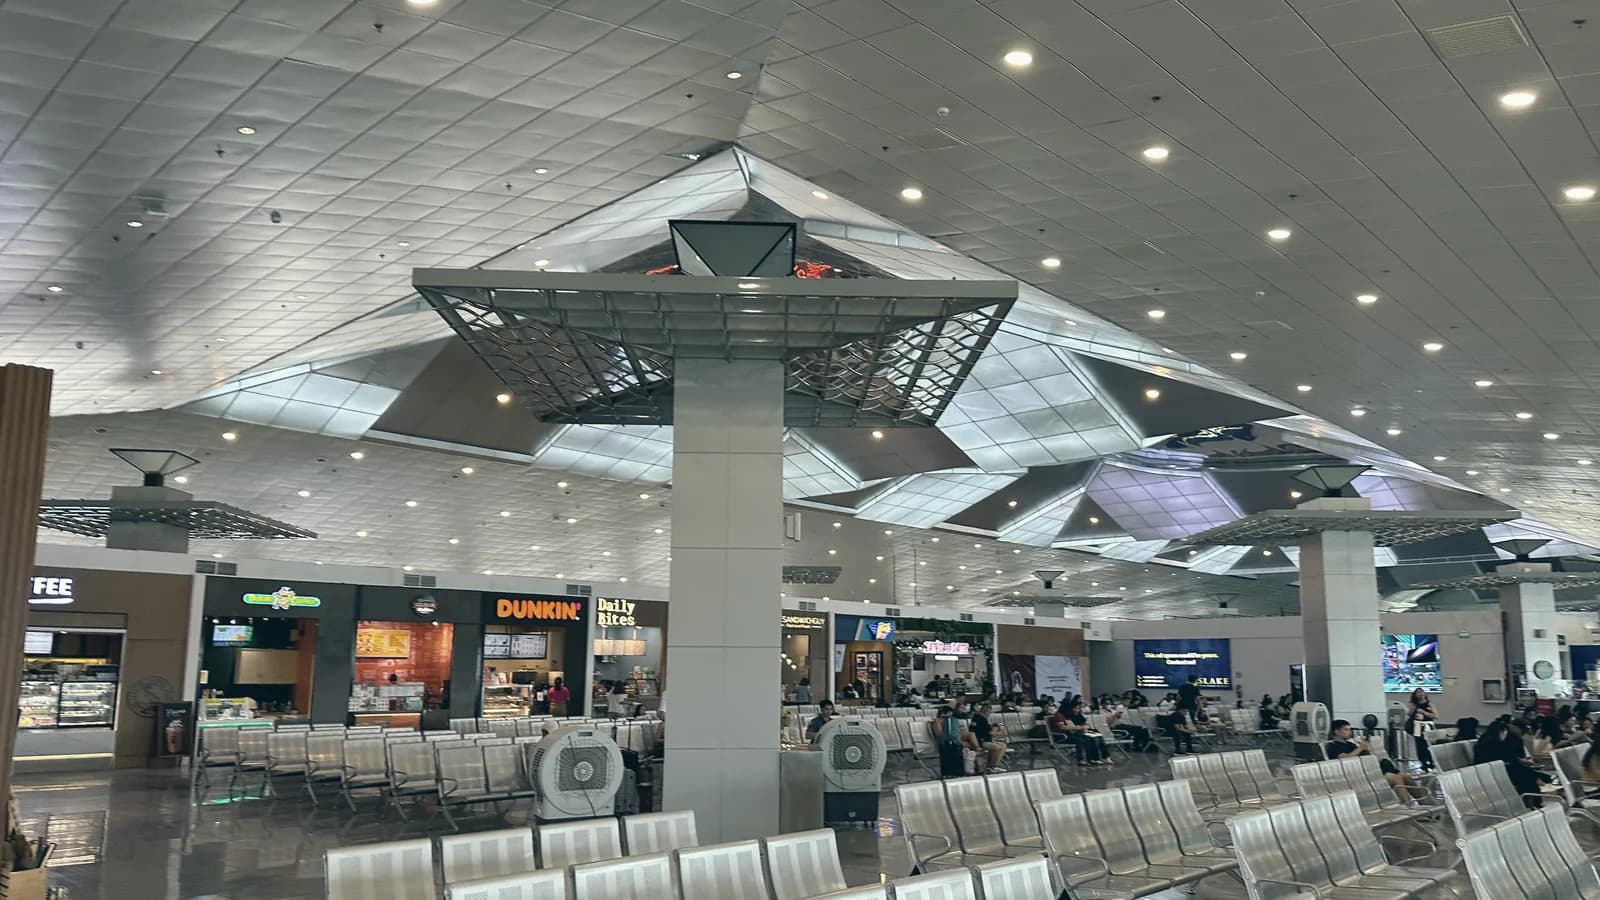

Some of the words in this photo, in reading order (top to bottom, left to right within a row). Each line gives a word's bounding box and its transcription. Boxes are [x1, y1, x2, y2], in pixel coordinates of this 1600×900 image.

[31, 577, 73, 596] FEE
[497, 599, 582, 620] DUNKIN'
[598, 598, 635, 614] Daily
[598, 612, 635, 626] Bites
